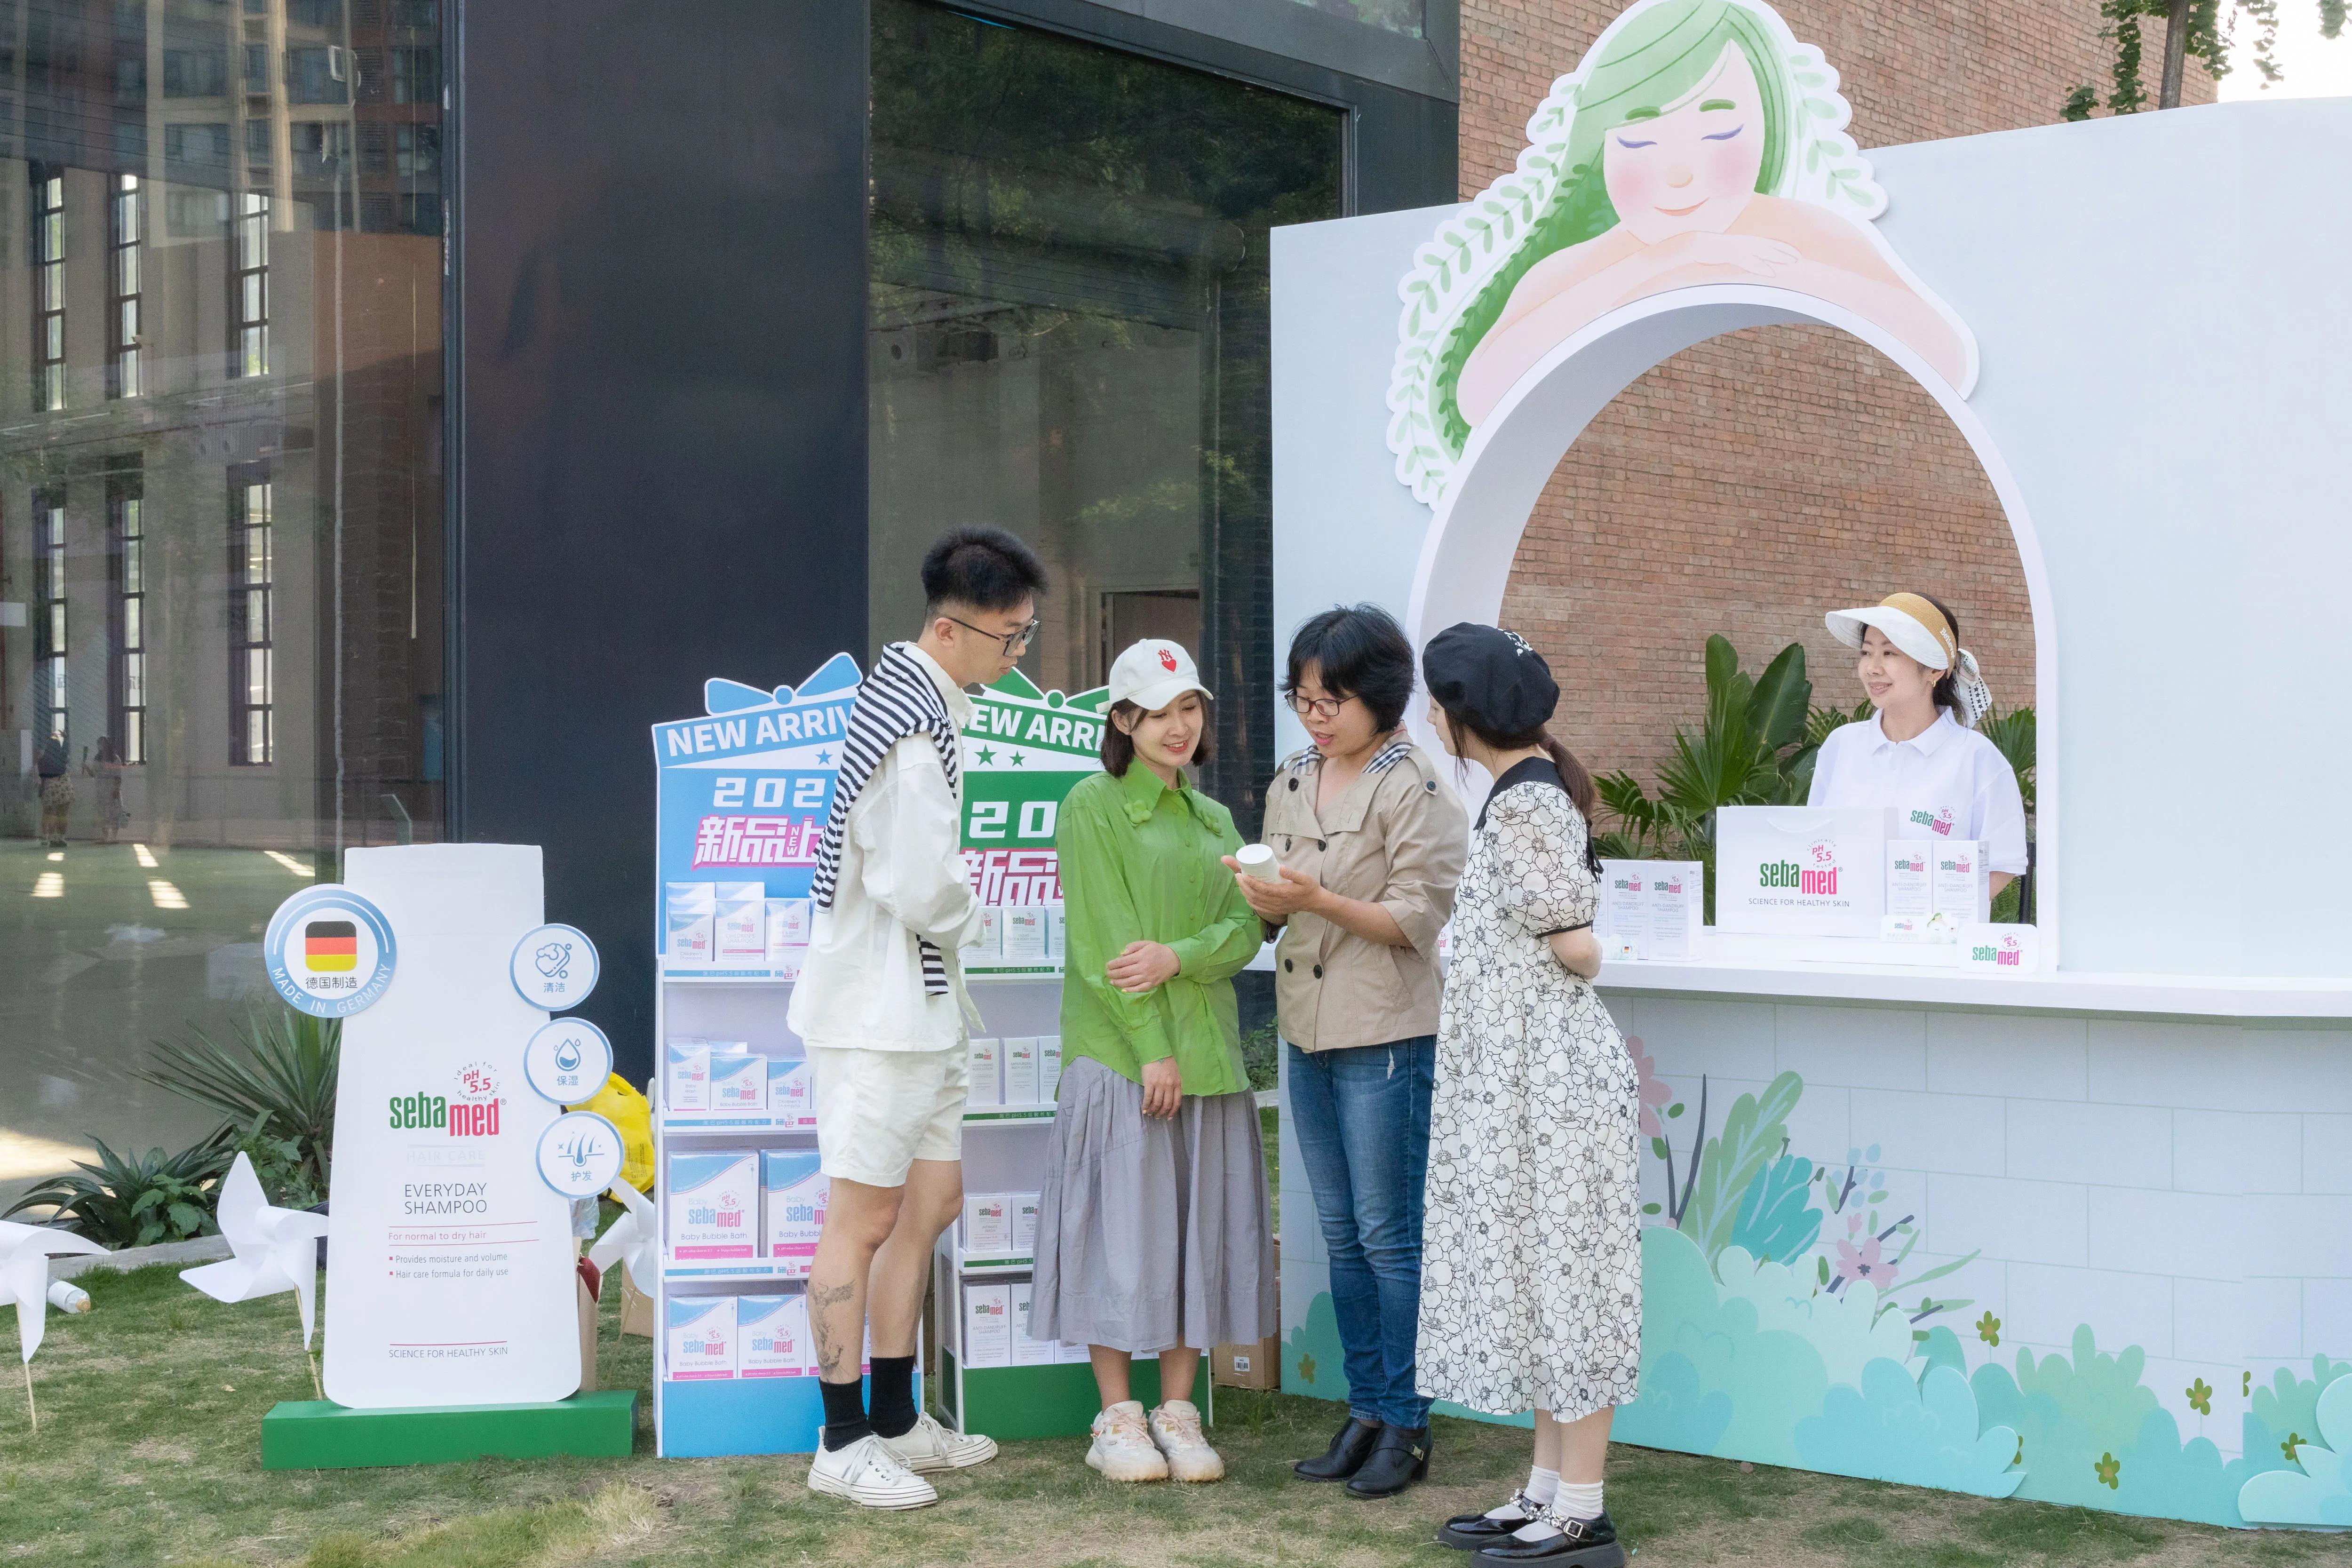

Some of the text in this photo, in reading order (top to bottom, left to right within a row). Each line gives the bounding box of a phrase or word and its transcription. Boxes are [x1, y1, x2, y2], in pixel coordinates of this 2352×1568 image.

[961, 706, 1023, 737] EW
[667, 719, 747, 756] NEW
[713, 778, 837, 807] 202
[969, 801, 1058, 838] 20
[787, 827, 799, 855] NEW
[1812, 844, 1823, 855] pH
[1817, 851, 1832, 862] 5.5
[1895, 860, 1923, 872] sebamed
[1941, 860, 1970, 873] sebamed
[1760, 860, 1837, 895] sebamed
[1615, 879, 1641, 891] sebamed
[1654, 881, 1681, 893] sebamed
[1972, 945, 2019, 965] sebamed
[272, 963, 390, 1013] MADE IN GERMANY
[306, 977, 358, 989] 德国制造
[543, 982, 565, 993] 清洁
[453, 1061, 497, 1080] Ideal for
[463, 1069, 479, 1084] pH
[470, 1077, 491, 1093] 5.5
[557, 1075, 579, 1086] 保湿
[457, 1082, 500, 1101] healthy skin
[389, 1091, 499, 1136] sebamed
[407, 1150, 484, 1162] HAIR CARE
[571, 1171, 593, 1182] 护发
[405, 1183, 487, 1197] EVERYDAY
[405, 1200, 487, 1214] SHAMPOO
[689, 1207, 741, 1227] sebamed
[452, 1232, 466, 1241] dry
[681, 1233, 700, 1242] Baby
[464, 1254, 478, 1262] and
[432, 1269, 461, 1278] formula
[476, 1268, 493, 1278] daily
[976, 1304, 1002, 1315] sebamed
[683, 1339, 723, 1355] sebamed
[753, 1337, 792, 1353] sebamed
[389, 1347, 508, 1358] SCIENCE FOR HEALTHY SKIN
